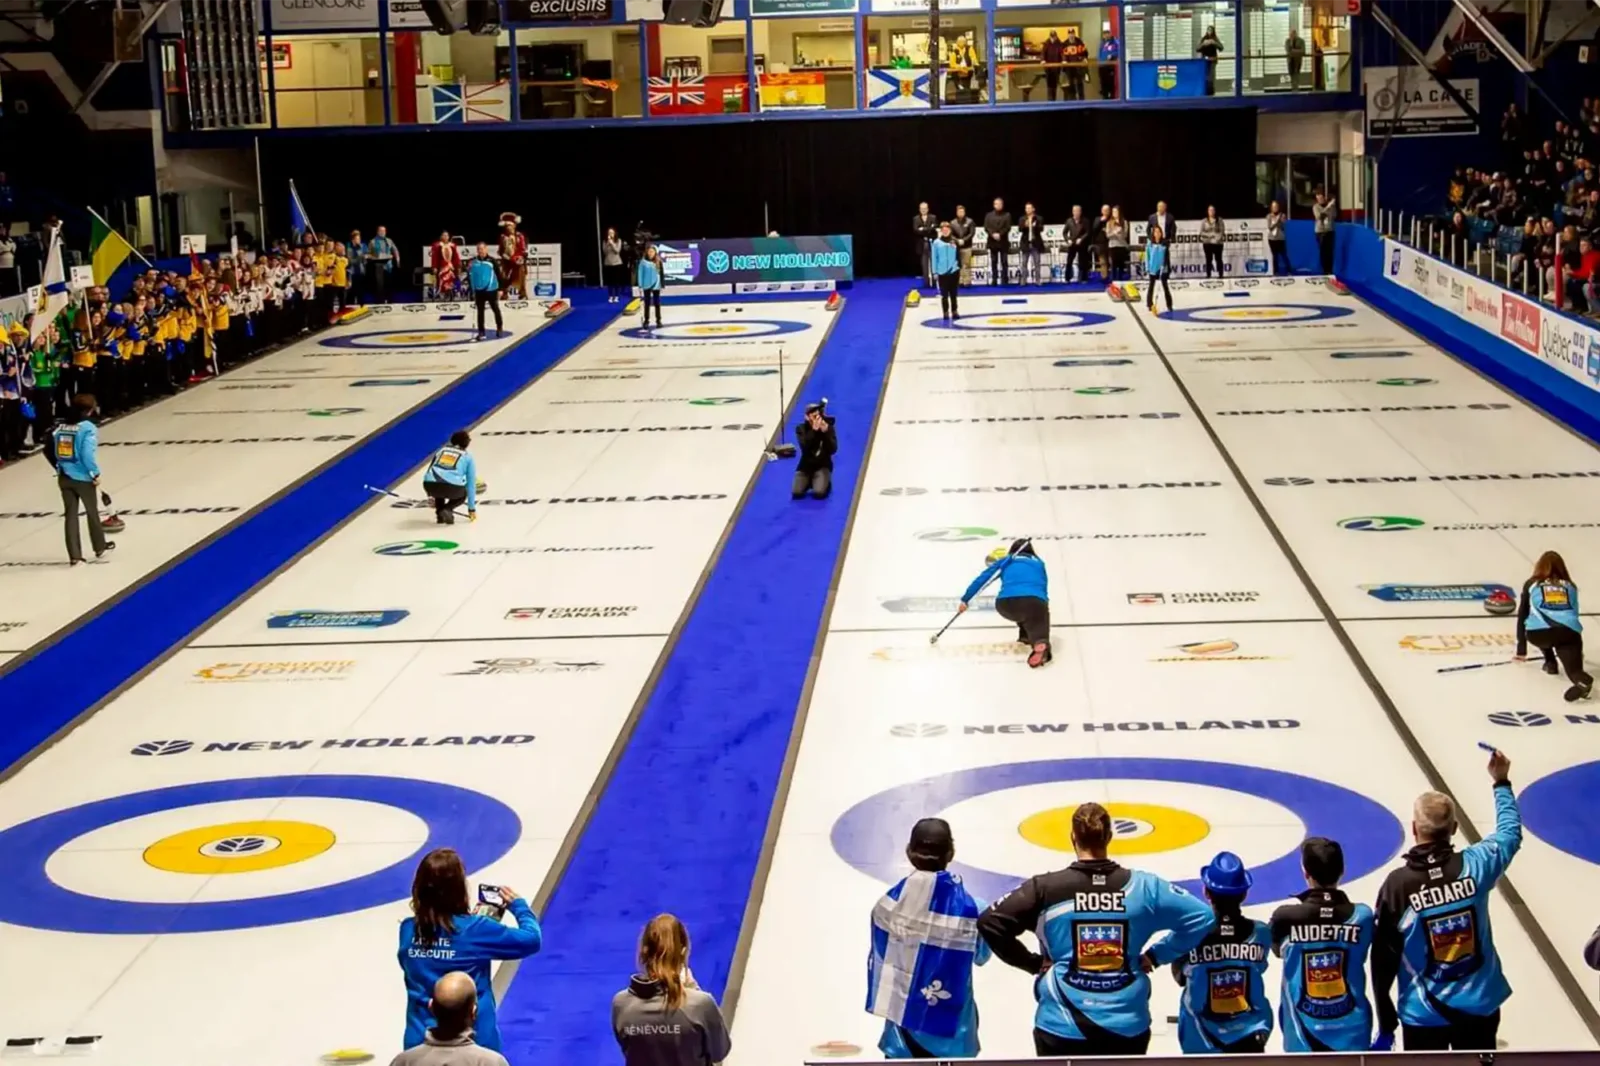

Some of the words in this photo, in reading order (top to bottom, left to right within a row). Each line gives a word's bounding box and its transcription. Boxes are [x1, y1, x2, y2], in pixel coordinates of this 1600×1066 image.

[1429, 88, 1474, 103] CAE
[732, 255, 771, 270] NEW
[773, 252, 850, 269] HOLLAND
[963, 723, 1069, 735] NEW
[1082, 719, 1301, 733] HOLLAND
[201, 740, 314, 753] NEW
[320, 734, 537, 749] HOLLAND
[1075, 892, 1125, 911] ROSE
[1409, 877, 1477, 912] BÉDARD
[1290, 924, 1360, 943] AUDETTE
